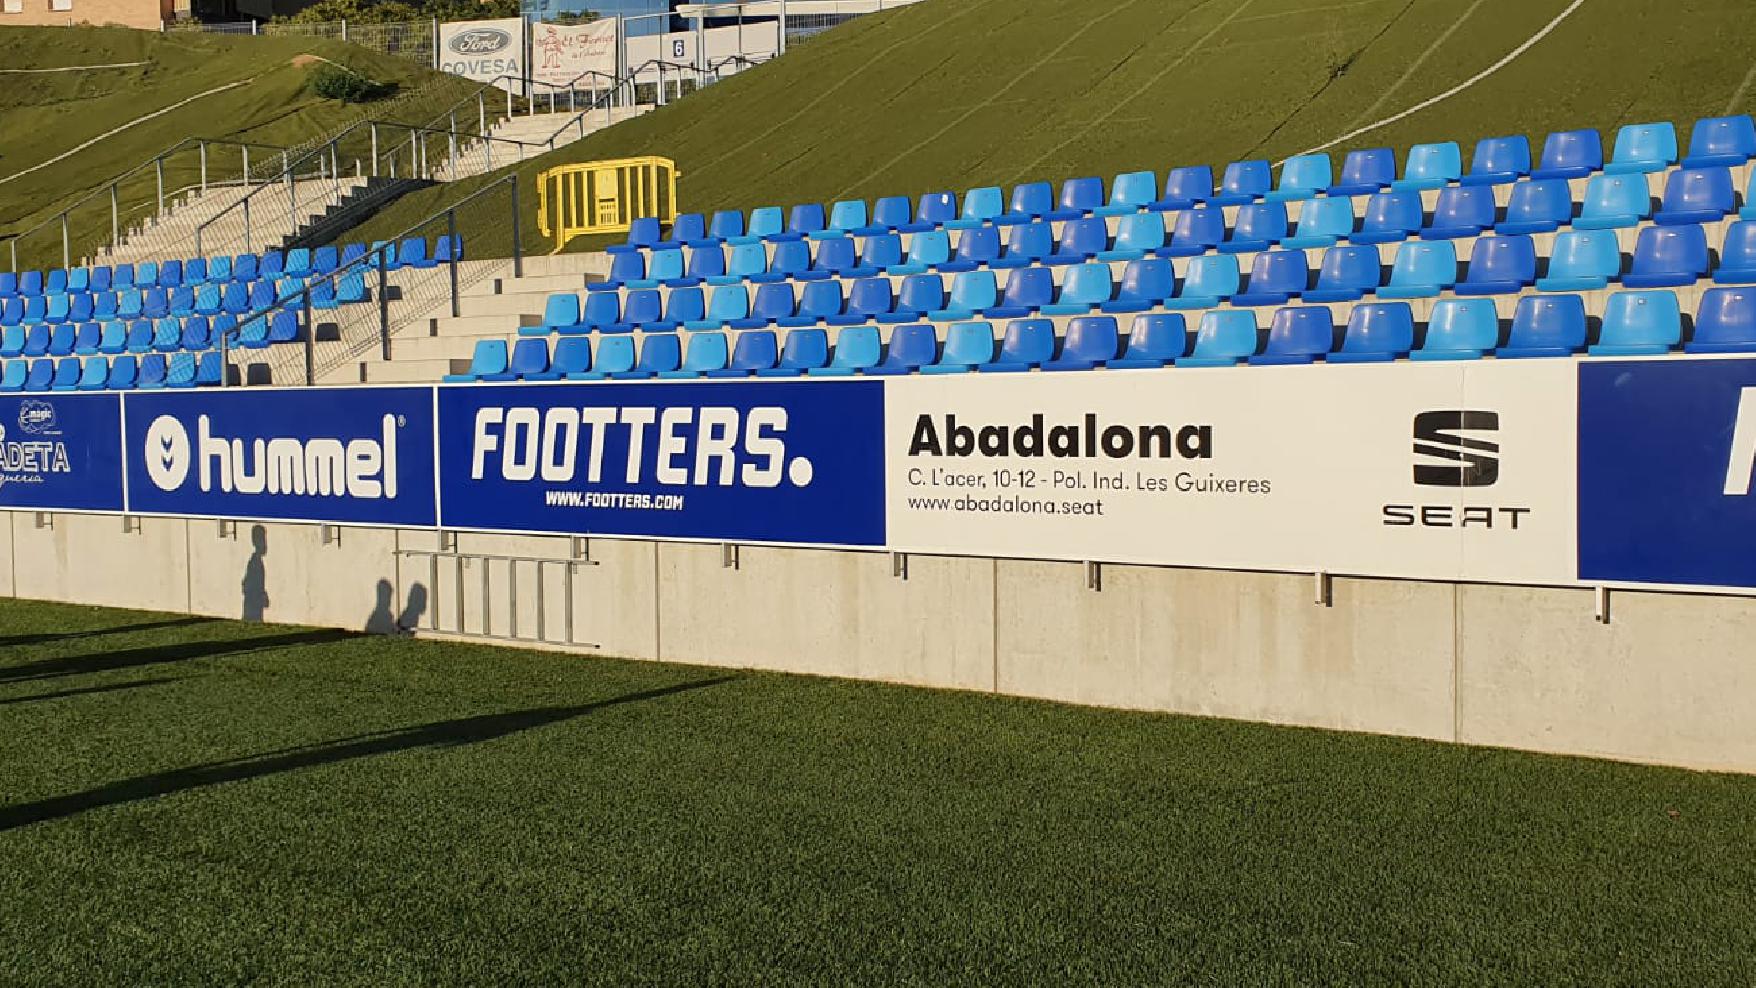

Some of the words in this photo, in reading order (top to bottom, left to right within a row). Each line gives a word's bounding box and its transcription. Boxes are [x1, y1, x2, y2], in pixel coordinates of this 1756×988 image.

[460, 33, 501, 51] Ford
[675, 42, 683, 56] 6
[442, 58, 519, 76] COVESA
[471, 406, 813, 488] FOOTTERS.
[907, 413, 1213, 459] Abadalona
[198, 413, 397, 499] hummel
[907, 467, 926, 486] C.
[931, 467, 987, 489] L'acer,
[992, 468, 1036, 489] 10-12
[1053, 470, 1087, 489] Pol.
[1093, 470, 1130, 490] Ind.
[1136, 471, 1168, 492] Les
[1174, 471, 1271, 495] Guixeres
[545, 490, 684, 511] WWW.FOOTTERS.COM
[907, 493, 1104, 516] www.abadalona.seat
[1382, 505, 1530, 530] SEAT
